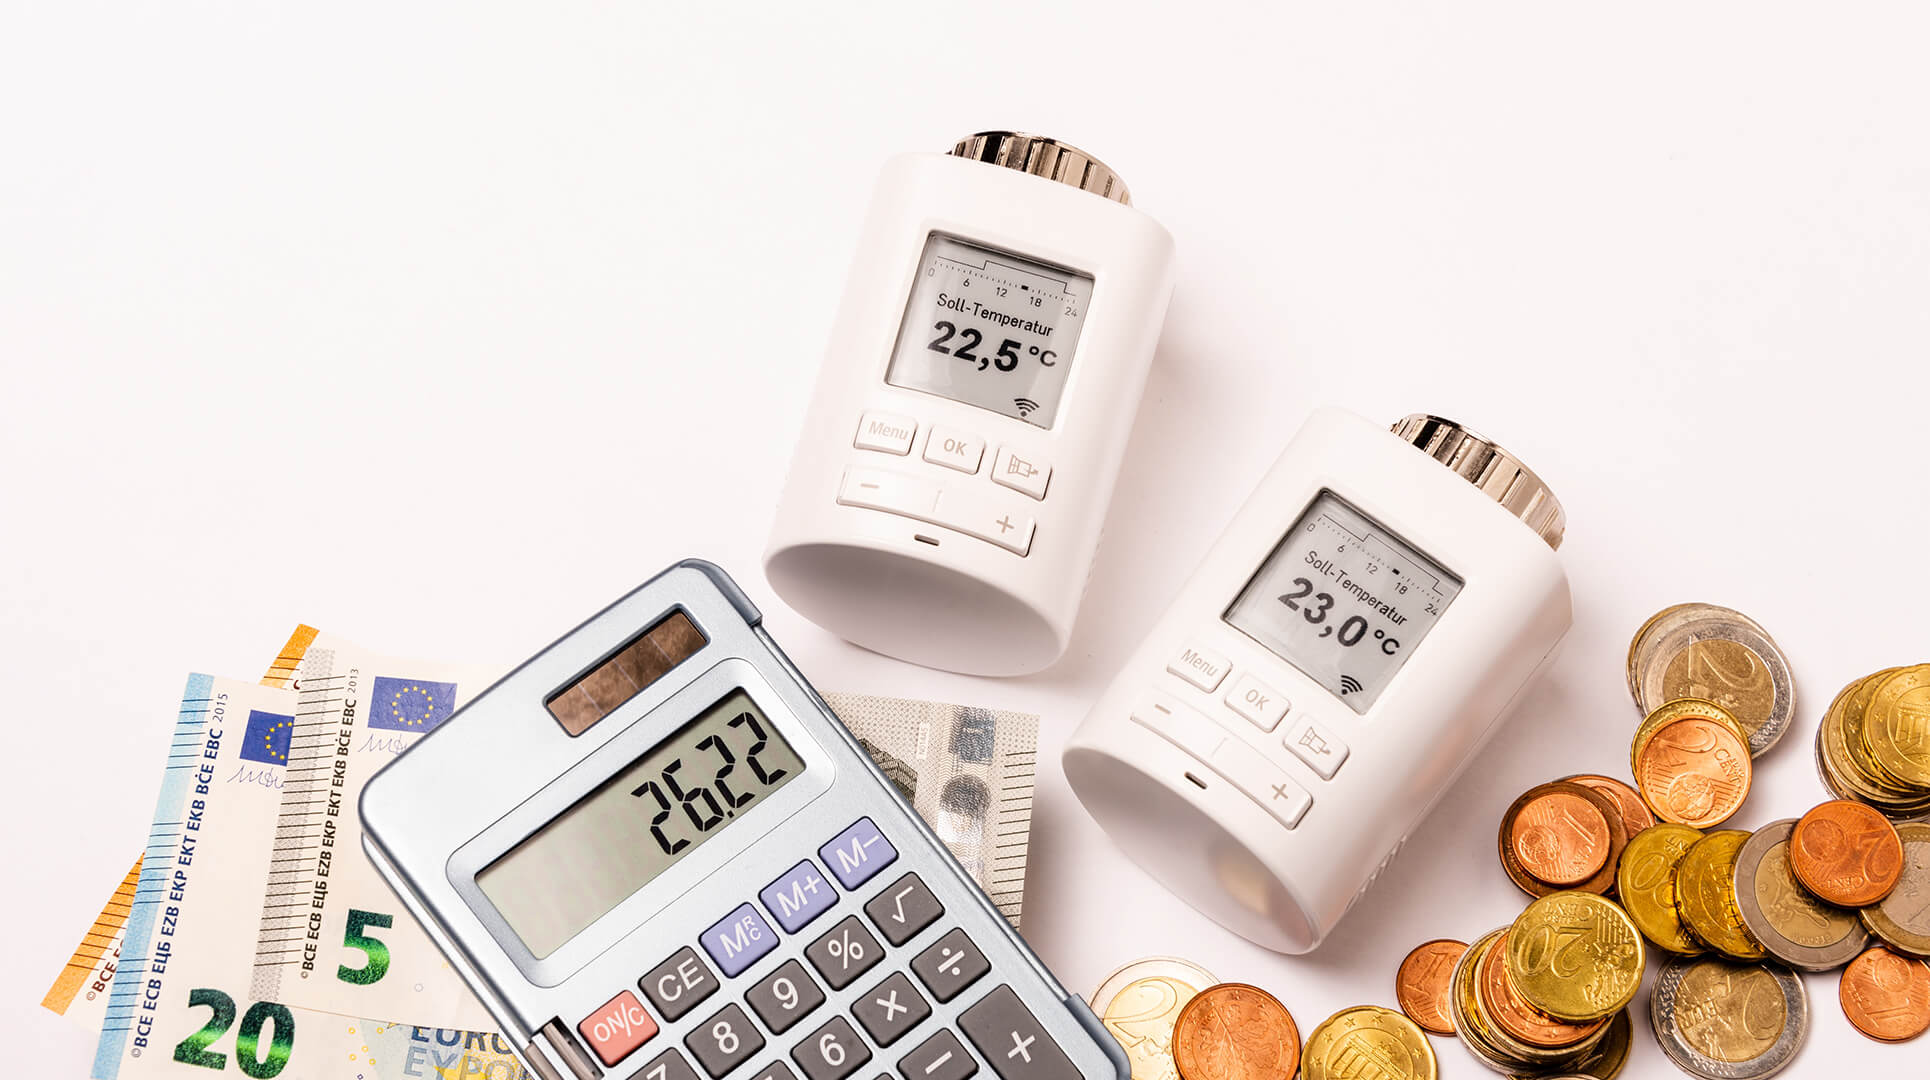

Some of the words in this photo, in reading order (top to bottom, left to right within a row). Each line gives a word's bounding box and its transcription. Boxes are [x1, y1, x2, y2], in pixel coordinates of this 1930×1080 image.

[963, 278, 971, 288] 6
[996, 287, 1008, 298] 12
[1030, 296, 1043, 308] 18
[1064, 307, 1078, 318] 24
[937, 293, 1054, 337] Soll-Temperatur
[927, 320, 1022, 372] 22,5
[868, 420, 909, 442] Menu
[943, 438, 968, 457] OK
[1304, 550, 1407, 626] Soll-Temperatur
[1337, 545, 1345, 553] 6
[1365, 562, 1378, 575] 12
[1394, 582, 1408, 595] 18
[1424, 603, 1438, 616] 24
[1277, 577, 1368, 647] 23,0
[1180, 648, 1219, 678] Menu
[348, 668, 359, 694] 2013
[212, 693, 228, 723] 2015
[342, 699, 357, 726] EBC
[1245, 688, 1270, 711] OK
[204, 728, 223, 760] EBC
[332, 760, 347, 787] EKB
[631, 712, 788, 855] 26.22
[187, 799, 205, 831] EKB
[322, 820, 336, 847] EKP
[317, 850, 332, 877] EZB
[169, 870, 187, 902] EKP
[161, 905, 179, 936] EZB
[337, 908, 393, 985] 5
[828, 929, 864, 969] %
[657, 957, 704, 1002] CE
[772, 977, 799, 1010] 9
[173, 988, 295, 1080] 20
[593, 1002, 645, 1042] ON/C
[712, 1021, 740, 1054] 8
[819, 1033, 846, 1066] 6
